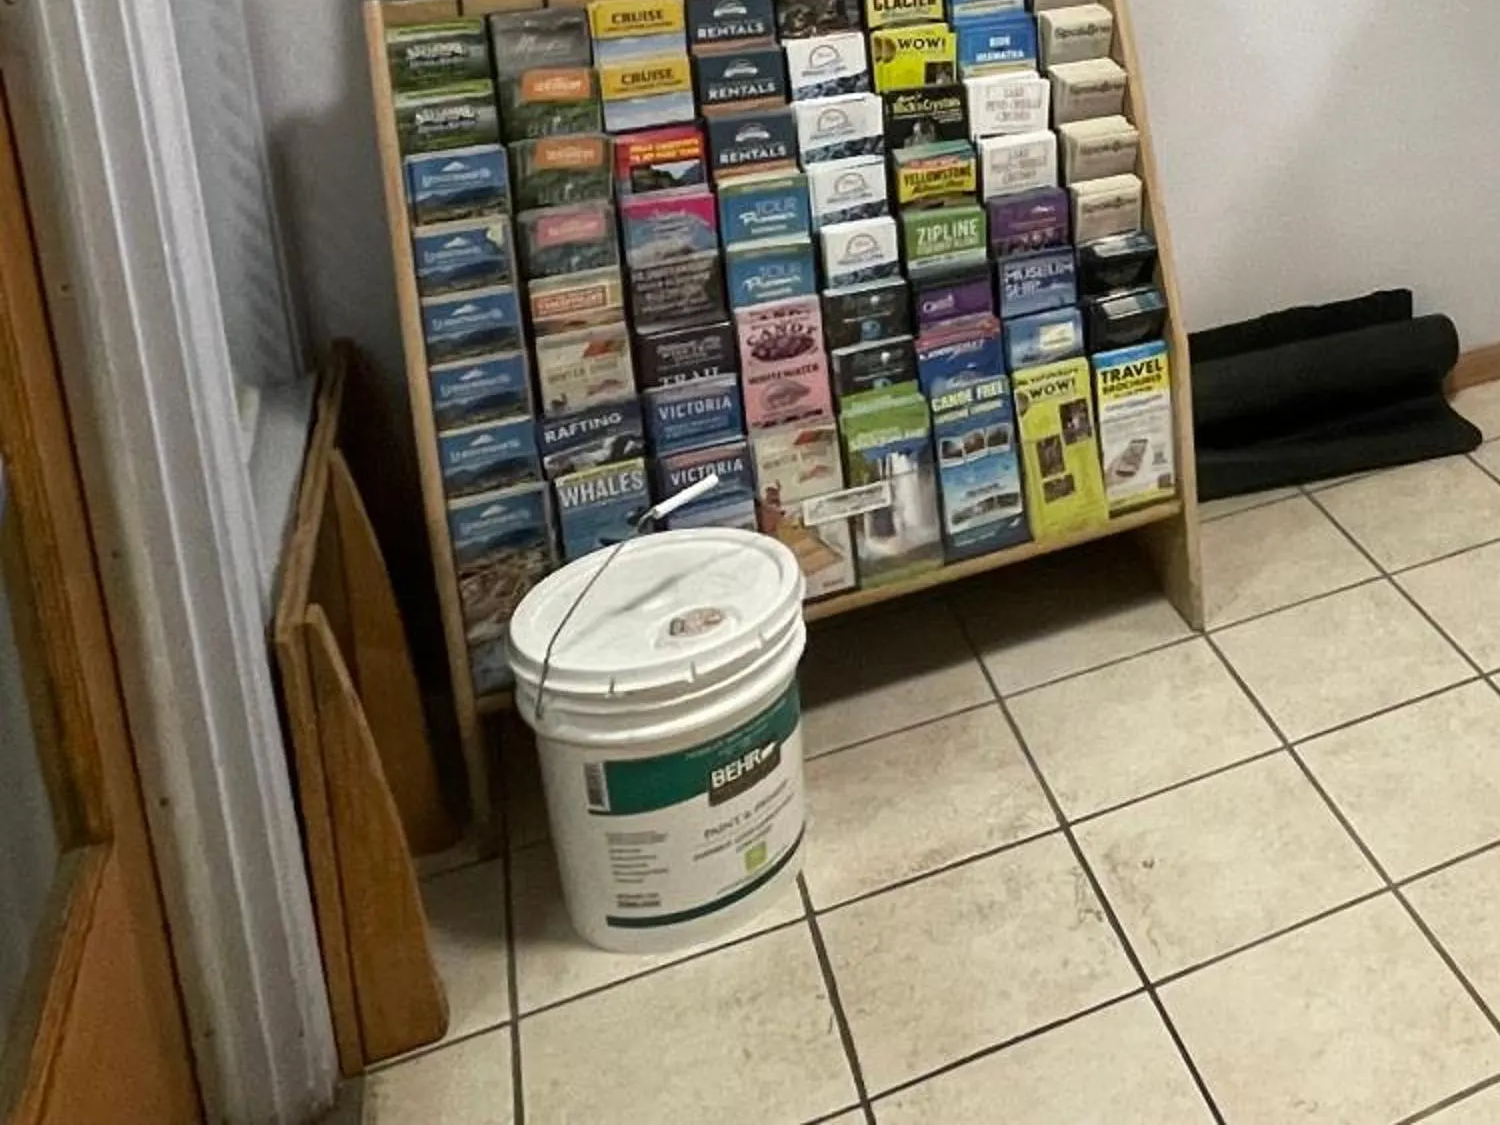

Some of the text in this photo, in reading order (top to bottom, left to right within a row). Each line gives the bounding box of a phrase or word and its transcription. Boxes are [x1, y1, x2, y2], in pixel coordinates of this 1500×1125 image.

[611, 9, 664, 25] CRUISE
[696, 22, 765, 39] RENTALS
[897, 37, 946, 50] WOW!
[621, 67, 674, 85] CRUISE
[708, 83, 776, 100] RENTALS
[719, 144, 787, 164] RENTALS
[917, 218, 980, 245] ZIPLINE
[1101, 359, 1163, 385] TRAVEL
[1030, 377, 1076, 400] WOW!
[658, 396, 732, 420] VICTORIA
[543, 412, 624, 444] RAFTING
[671, 459, 744, 486] VICTORIA
[559, 470, 645, 508] WHALES
[710, 748, 762, 789] BEHR
